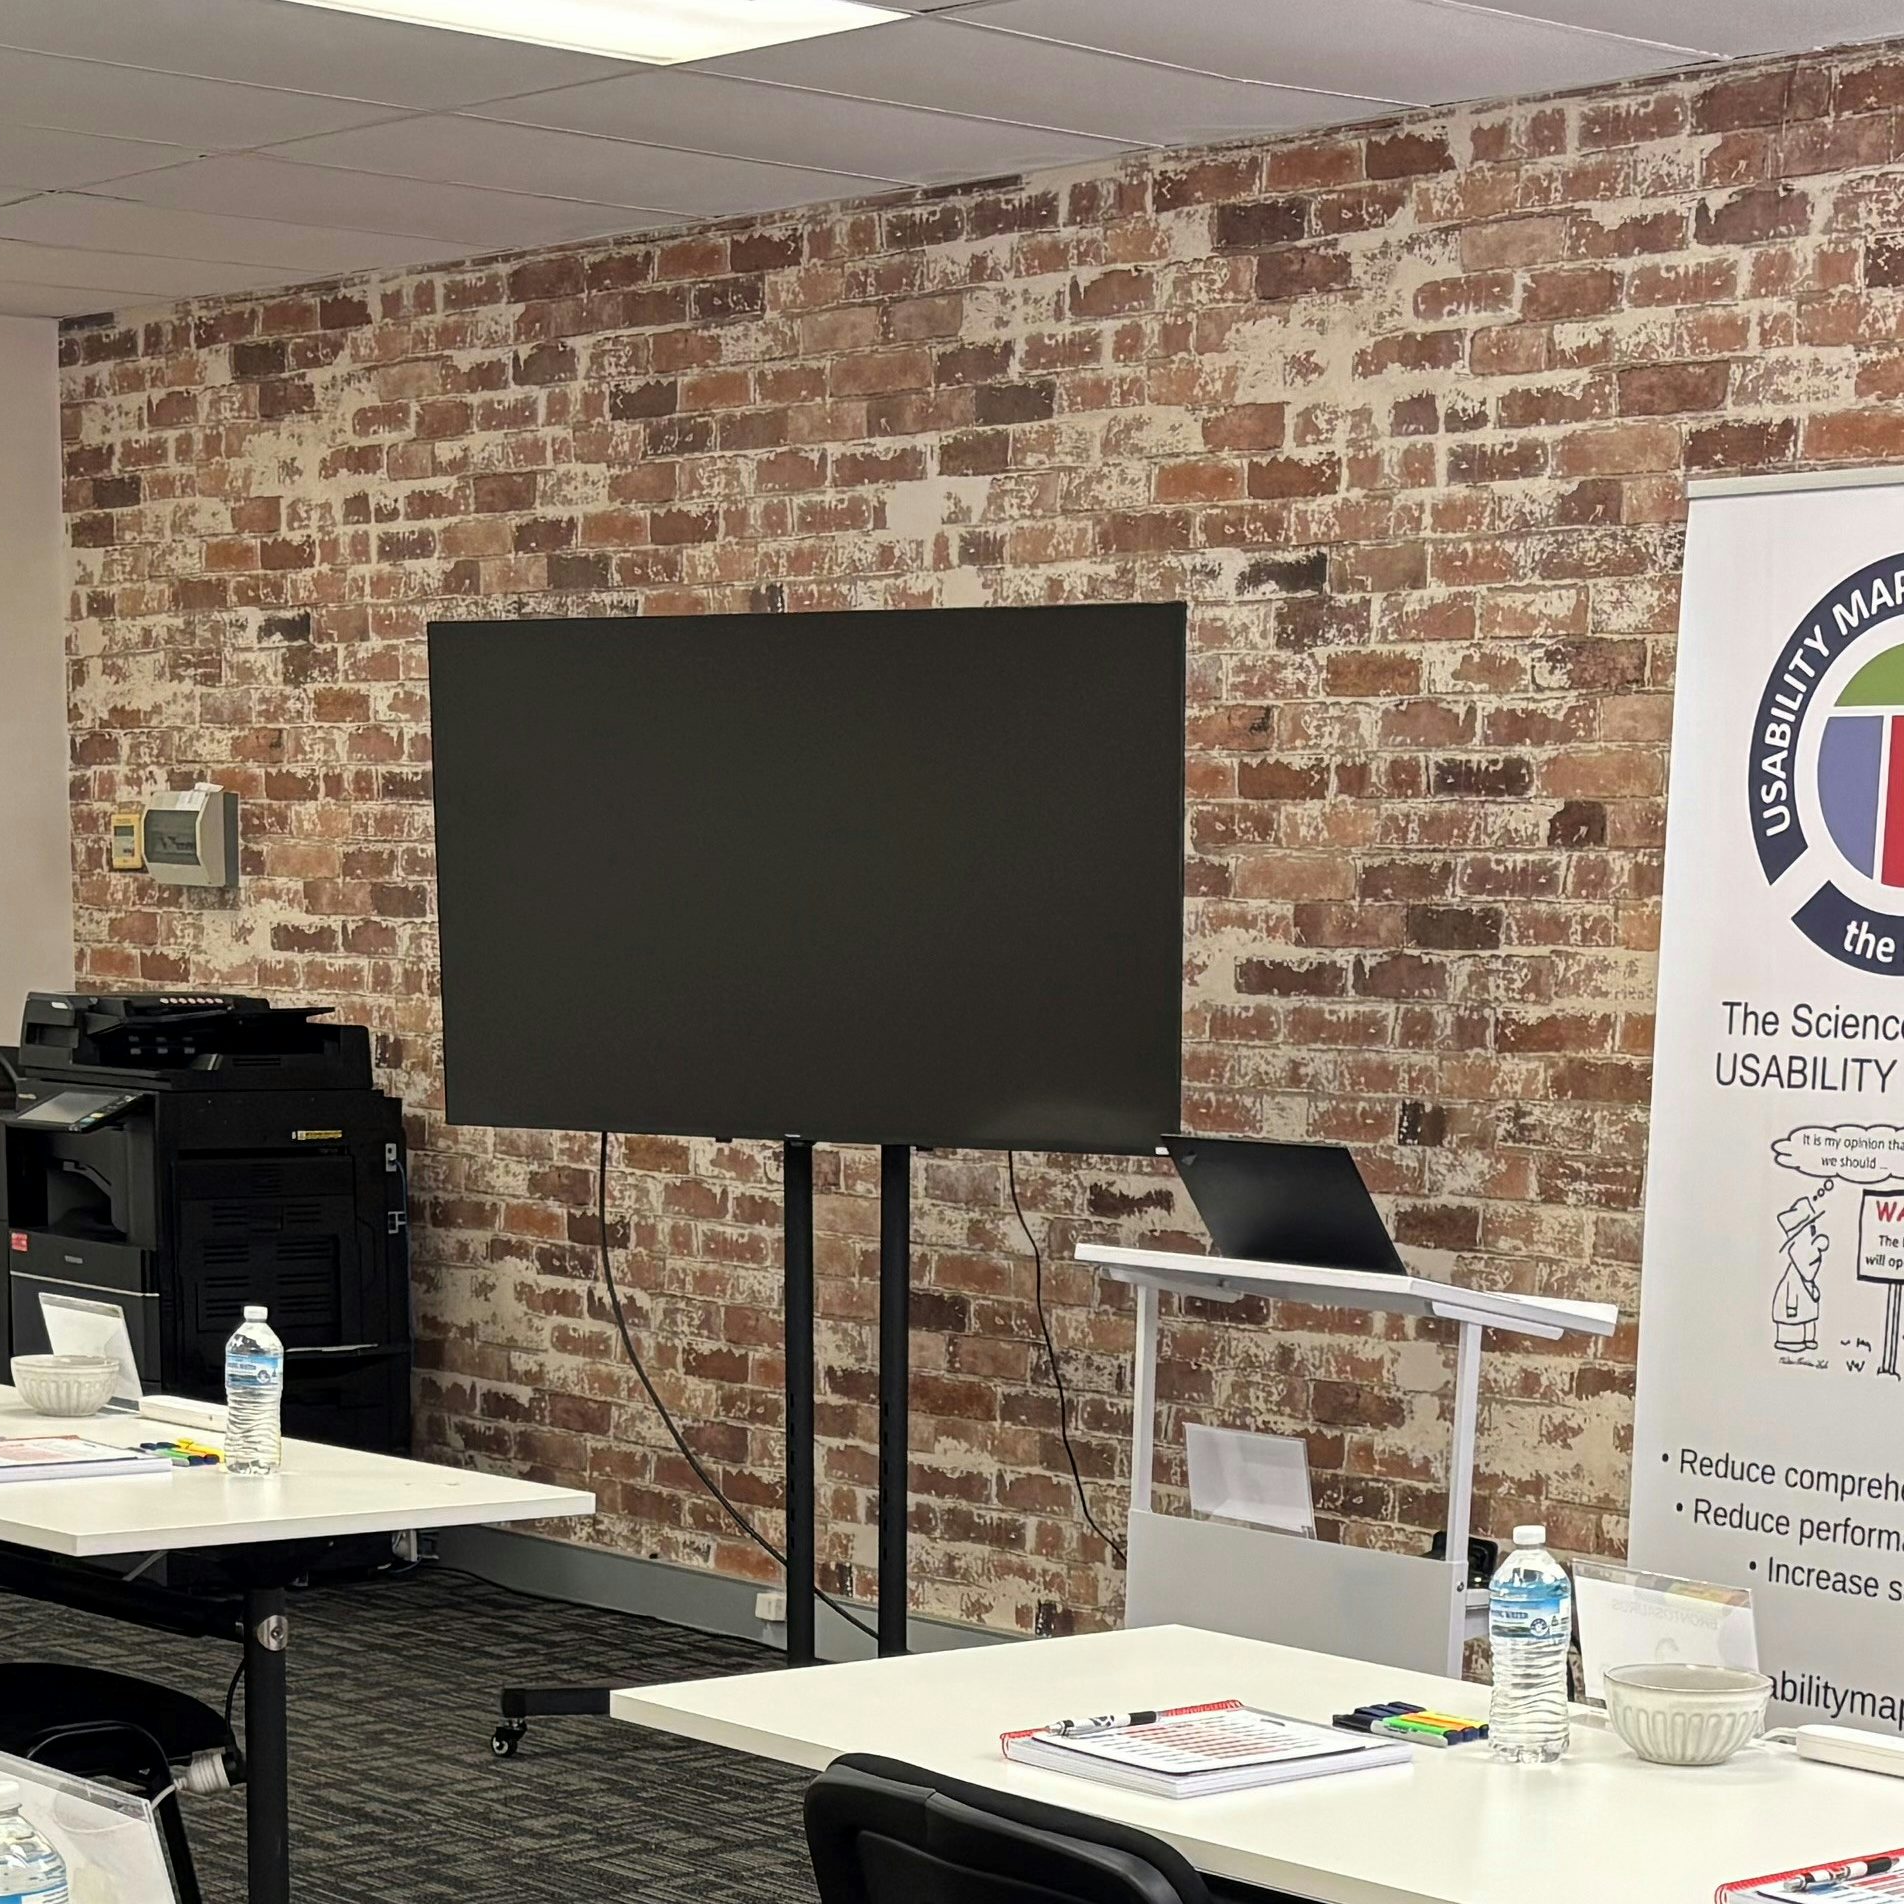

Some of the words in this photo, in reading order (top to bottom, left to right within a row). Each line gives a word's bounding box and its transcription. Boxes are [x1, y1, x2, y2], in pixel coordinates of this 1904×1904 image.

[1760, 624, 1830, 837] USABILITY
[1842, 920, 1896, 964] the
[1721, 1001, 1780, 1037] The
[1715, 1052, 1898, 1094] USABILITY
[1802, 1133, 1811, 1146] It
[1813, 1134, 1823, 1146] is
[1824, 1137, 1842, 1149] my
[1843, 1136, 1886, 1152] opinion
[1821, 1157, 1838, 1168] we
[1840, 1156, 1877, 1170] should
[1865, 1253, 1886, 1267] will
[1878, 1234, 1899, 1248] The
[1679, 1448, 1776, 1486] Reduce
[1693, 1497, 1791, 1537] Reduce
[1767, 1555, 1880, 1599] Increase
